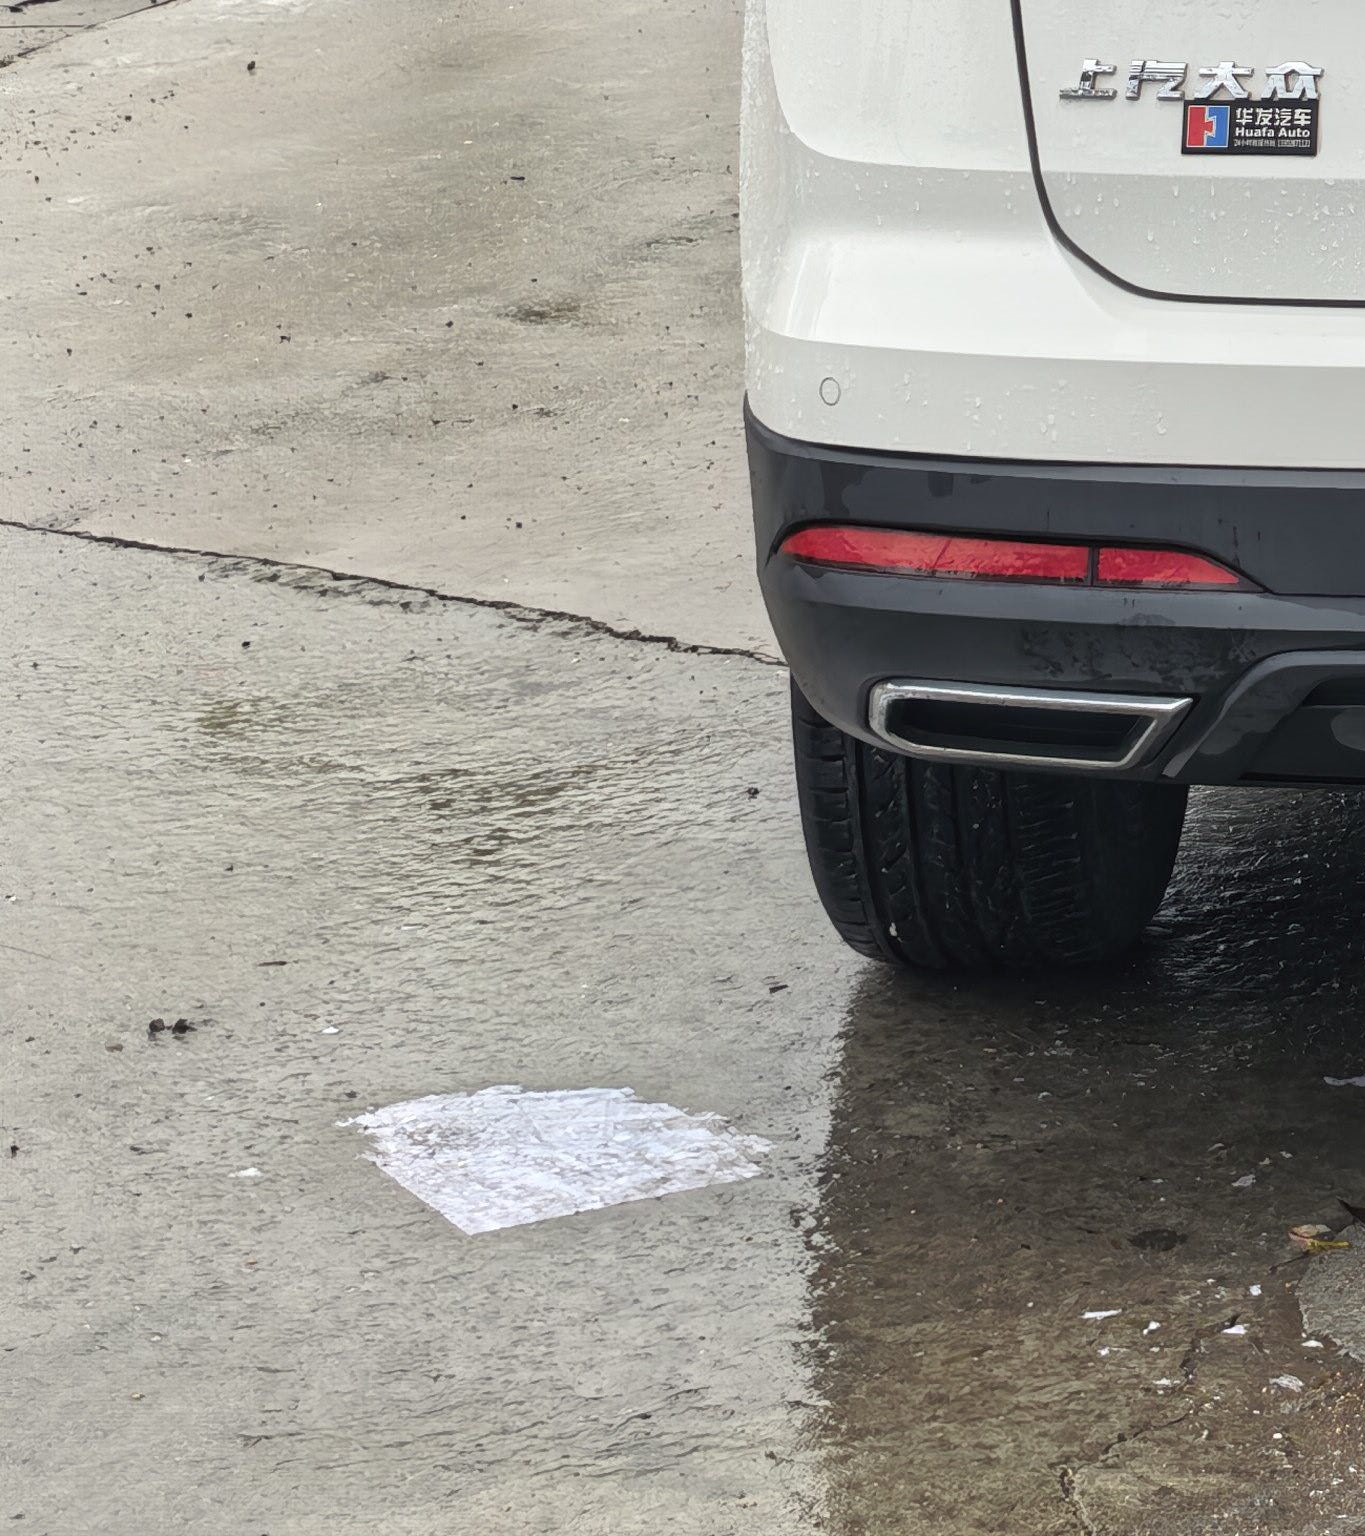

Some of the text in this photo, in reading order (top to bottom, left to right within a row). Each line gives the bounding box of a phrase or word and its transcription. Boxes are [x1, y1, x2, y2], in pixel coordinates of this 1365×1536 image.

[1059, 58, 1323, 100] 上汽大众
[1235, 107, 1312, 127] 华发汽车
[1235, 126, 1310, 138] Huafa Auto
